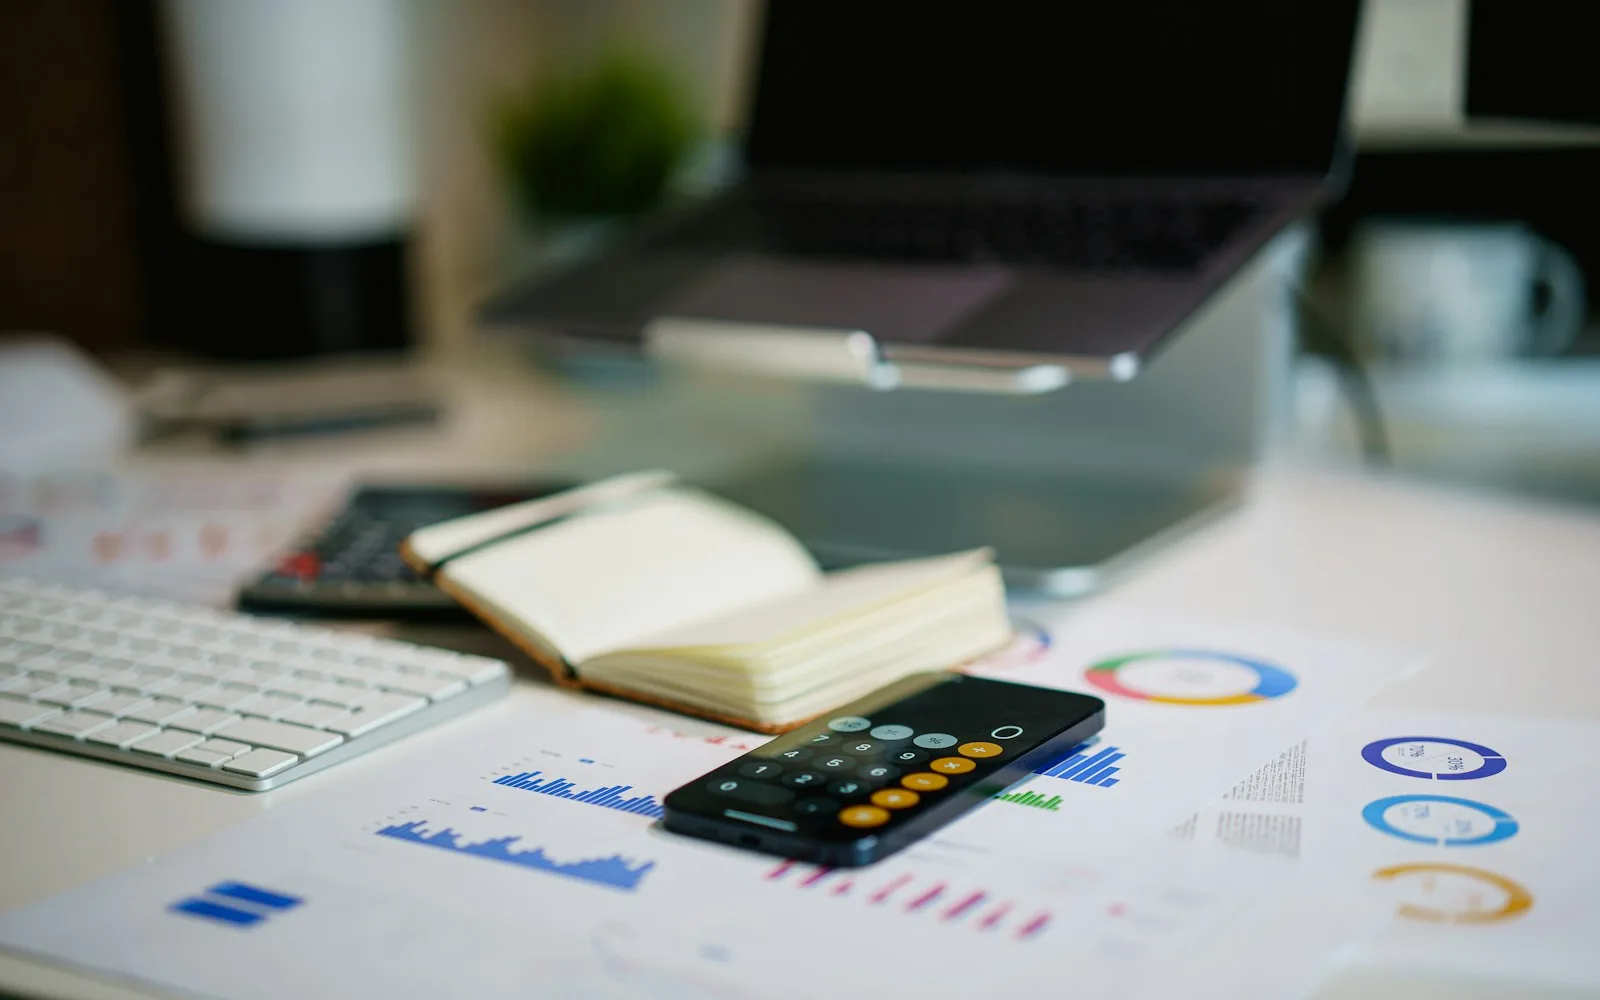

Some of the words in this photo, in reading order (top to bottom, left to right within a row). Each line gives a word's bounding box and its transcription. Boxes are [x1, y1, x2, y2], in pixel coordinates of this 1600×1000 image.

[991, 725, 1024, 740] 0
[855, 743, 871, 751] 8
[899, 752, 915, 760] 9
[784, 750, 799, 758] 4
[826, 758, 843, 767] 5
[870, 768, 887, 776] 6
[755, 766, 767, 774] 1
[794, 774, 812, 784] 2
[720, 781, 737, 791] 0
